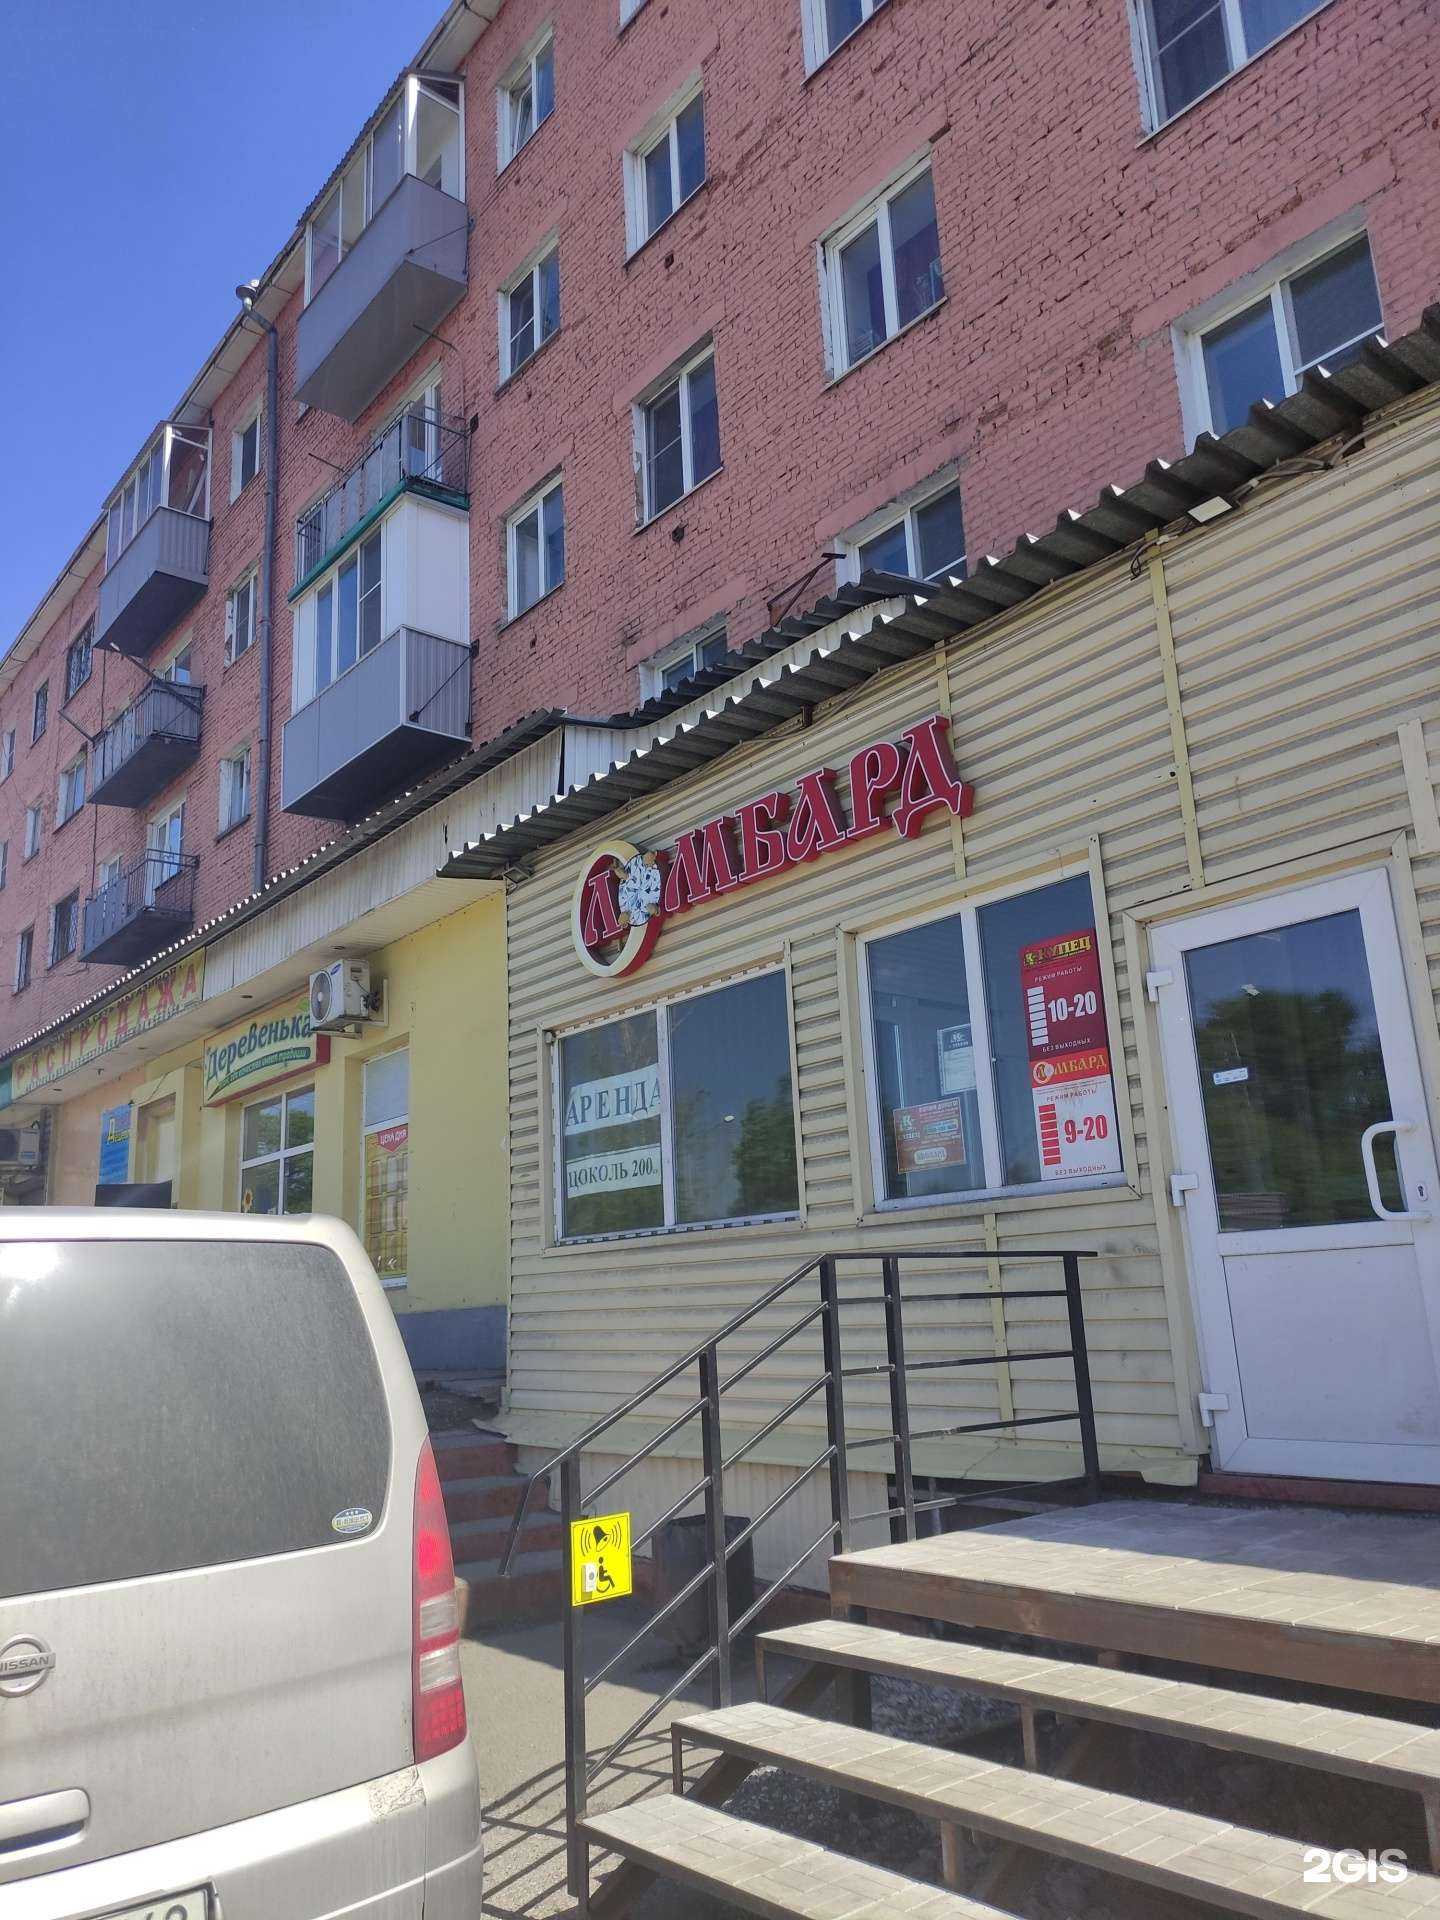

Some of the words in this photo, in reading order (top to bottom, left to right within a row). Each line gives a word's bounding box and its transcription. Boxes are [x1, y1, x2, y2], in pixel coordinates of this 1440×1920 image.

[1035, 972, 1056, 982] РЕЖИМ
[1057, 966, 1082, 977] РАБОТЫ
[1048, 991, 1097, 1023] 10-20
[15, 963, 198, 1090] РАСПРОДАЖА
[205, 1013, 313, 1088] Деревенька
[1042, 1045, 1054, 1053] БЕЗ
[1055, 1038, 1091, 1050] ВЫХОДНЫХ
[566, 1077, 661, 1128] АРЕНДА
[1046, 1092, 1069, 1102] РЕЖИМ
[1070, 1087, 1097, 1099] РАБОТЫ
[1064, 1115, 1108, 1144] 9-20
[568, 1161, 629, 1191] ЦОКОЛЬ
[1068, 1164, 1106, 1175] ВЫХОДНЫХ
